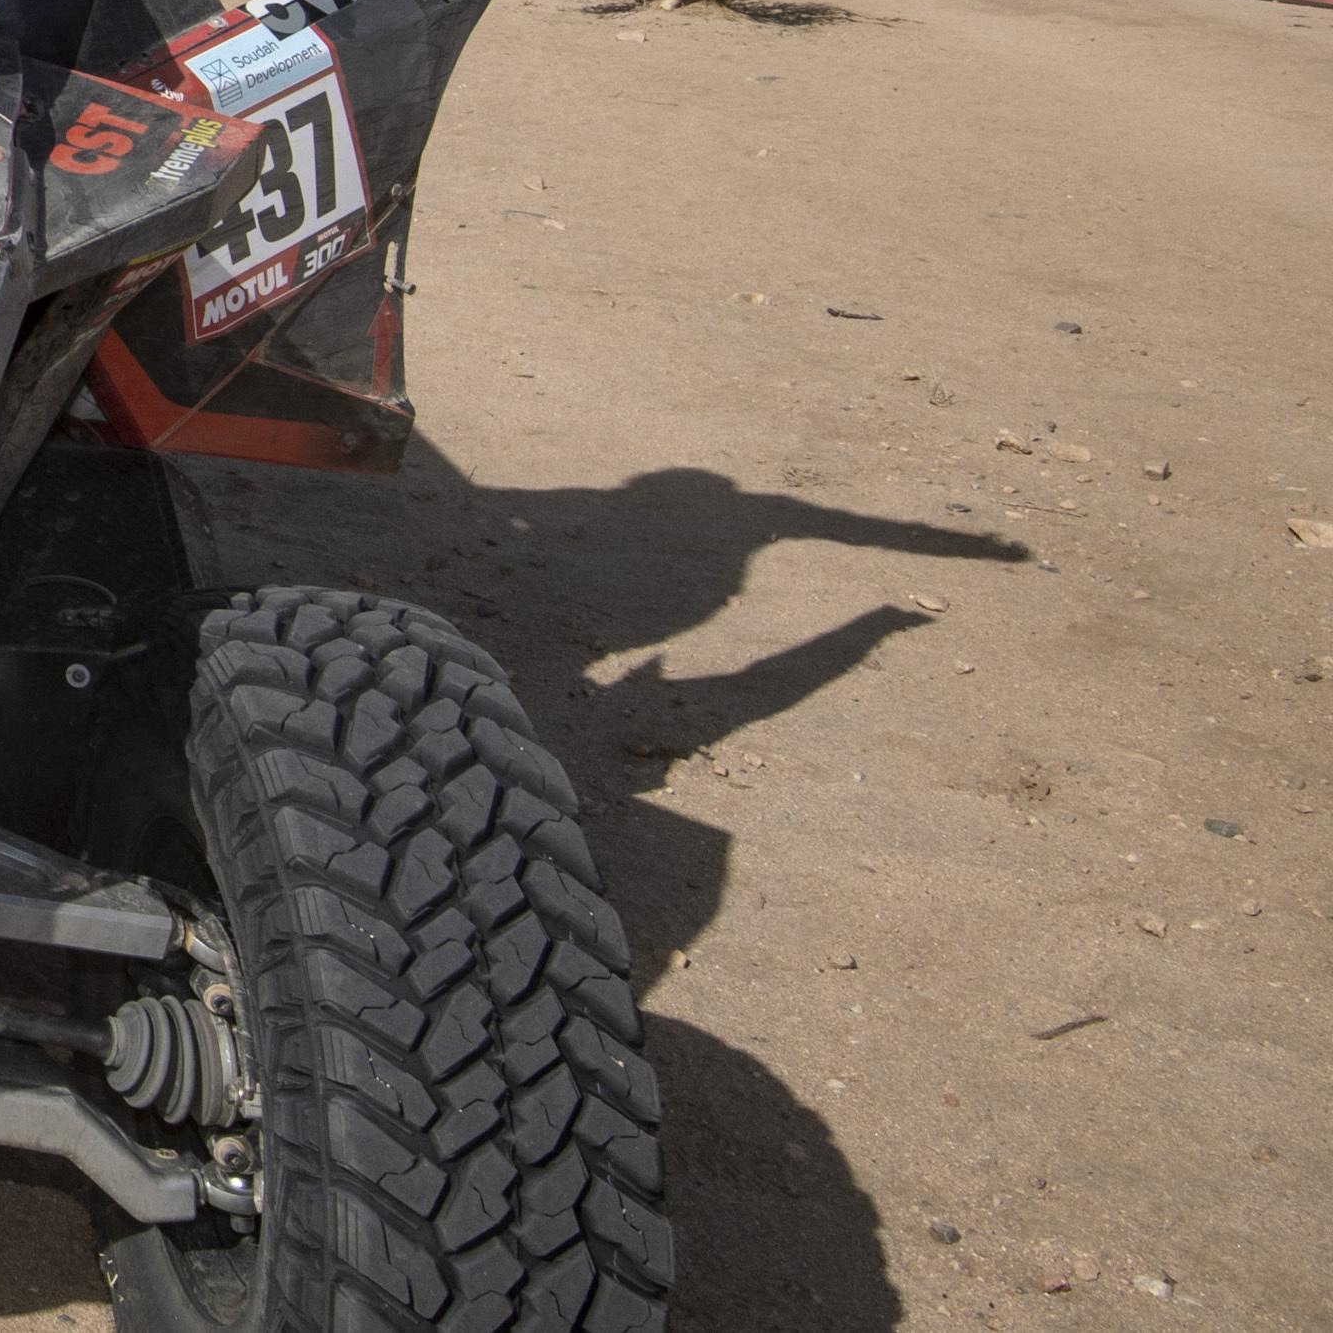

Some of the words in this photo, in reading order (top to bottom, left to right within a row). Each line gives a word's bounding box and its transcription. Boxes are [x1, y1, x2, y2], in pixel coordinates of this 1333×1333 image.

[232, 40, 280, 69] Soudah
[244, 42, 322, 90] Development
[49, 102, 149, 176] CST
[201, 262, 289, 329] MOTUL
